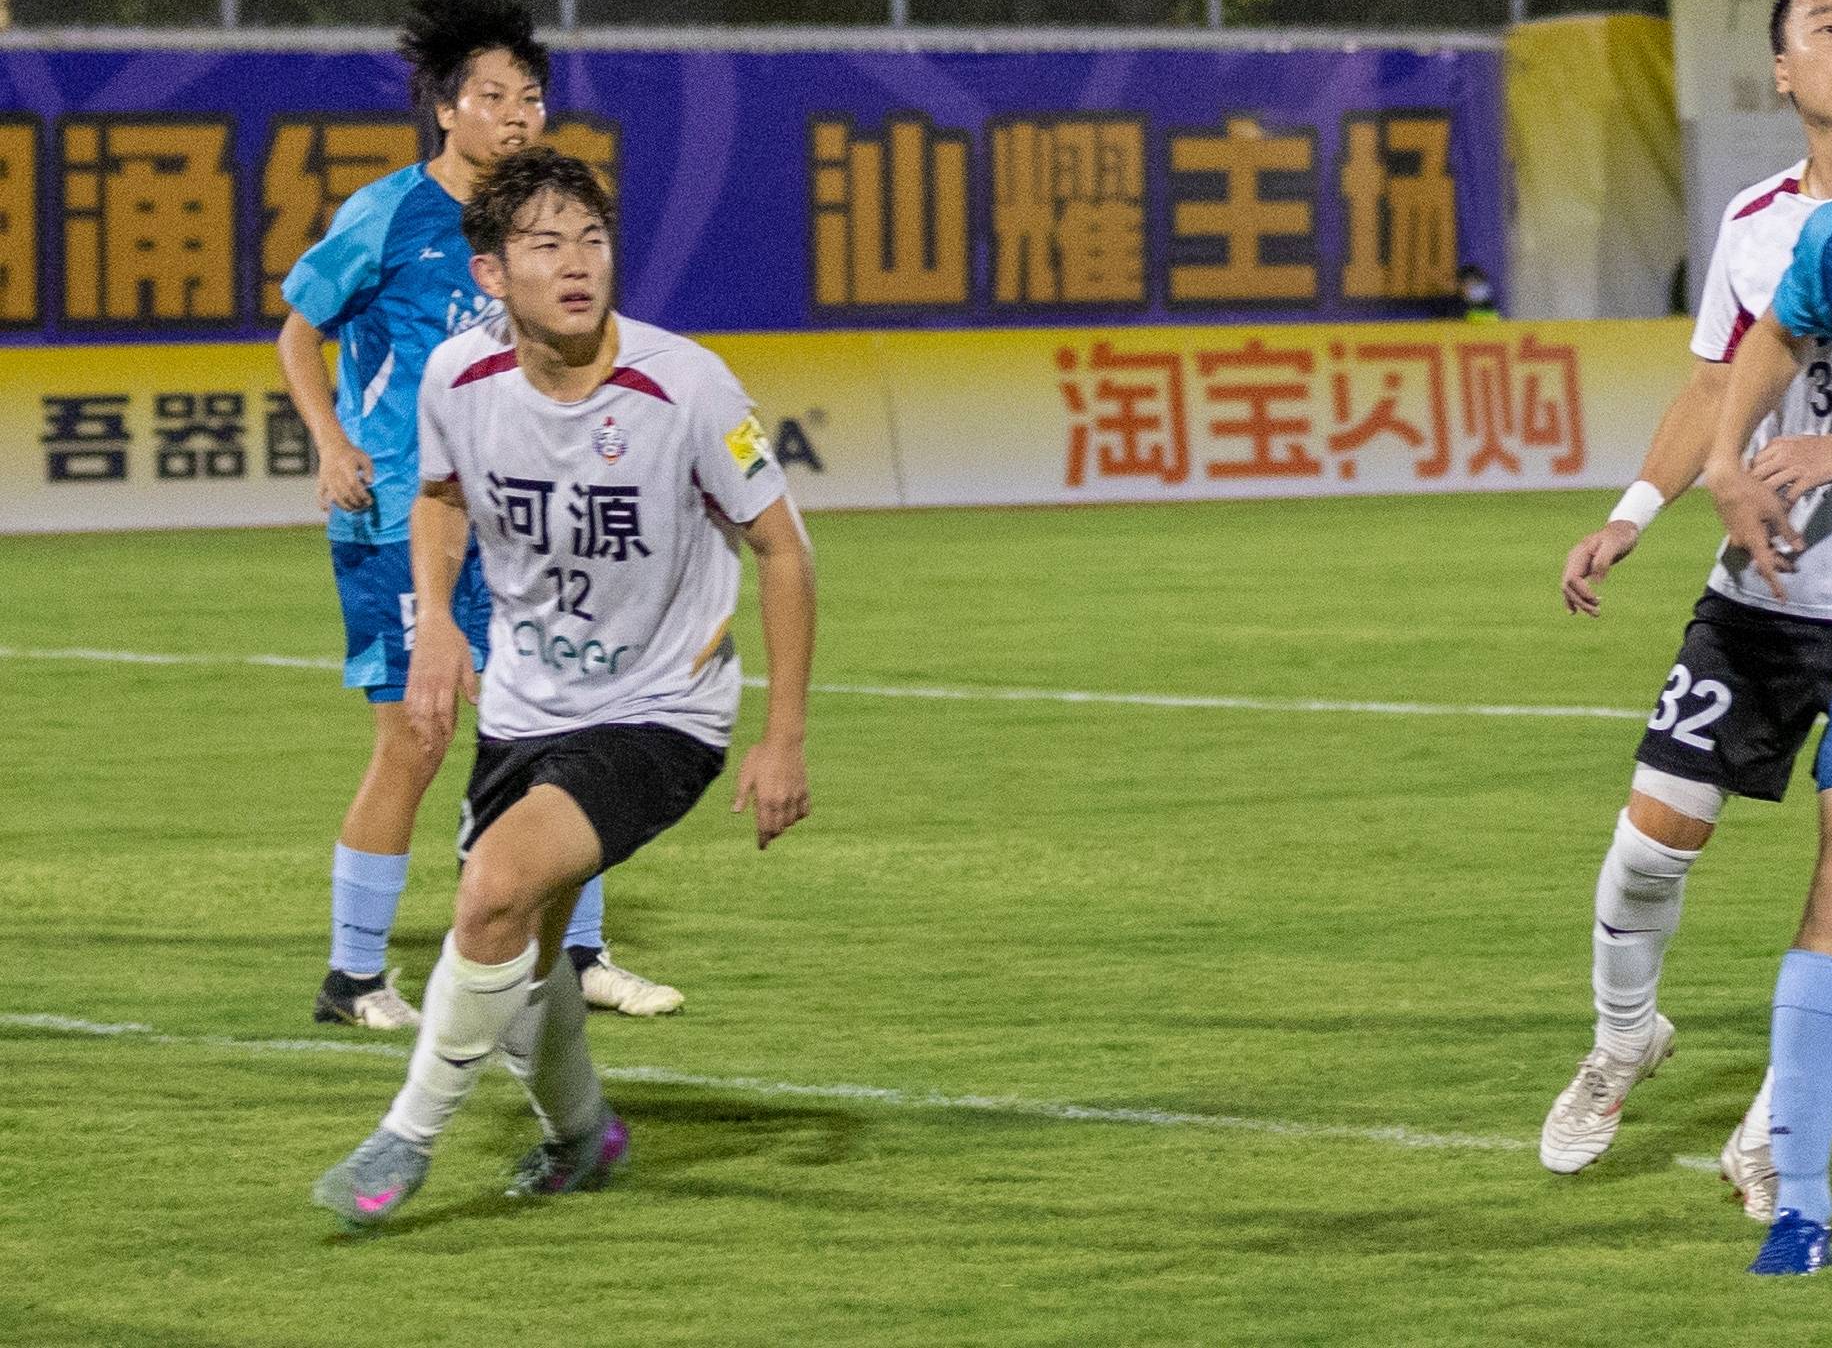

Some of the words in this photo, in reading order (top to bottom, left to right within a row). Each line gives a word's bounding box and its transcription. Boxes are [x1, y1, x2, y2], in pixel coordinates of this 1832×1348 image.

[811, 115, 1460, 306] 汕耀主场
[1055, 339, 1588, 488] 淘宝闪购
[487, 471, 652, 562] 河源
[544, 565, 594, 622] 12
[1647, 663, 1733, 751] 32
